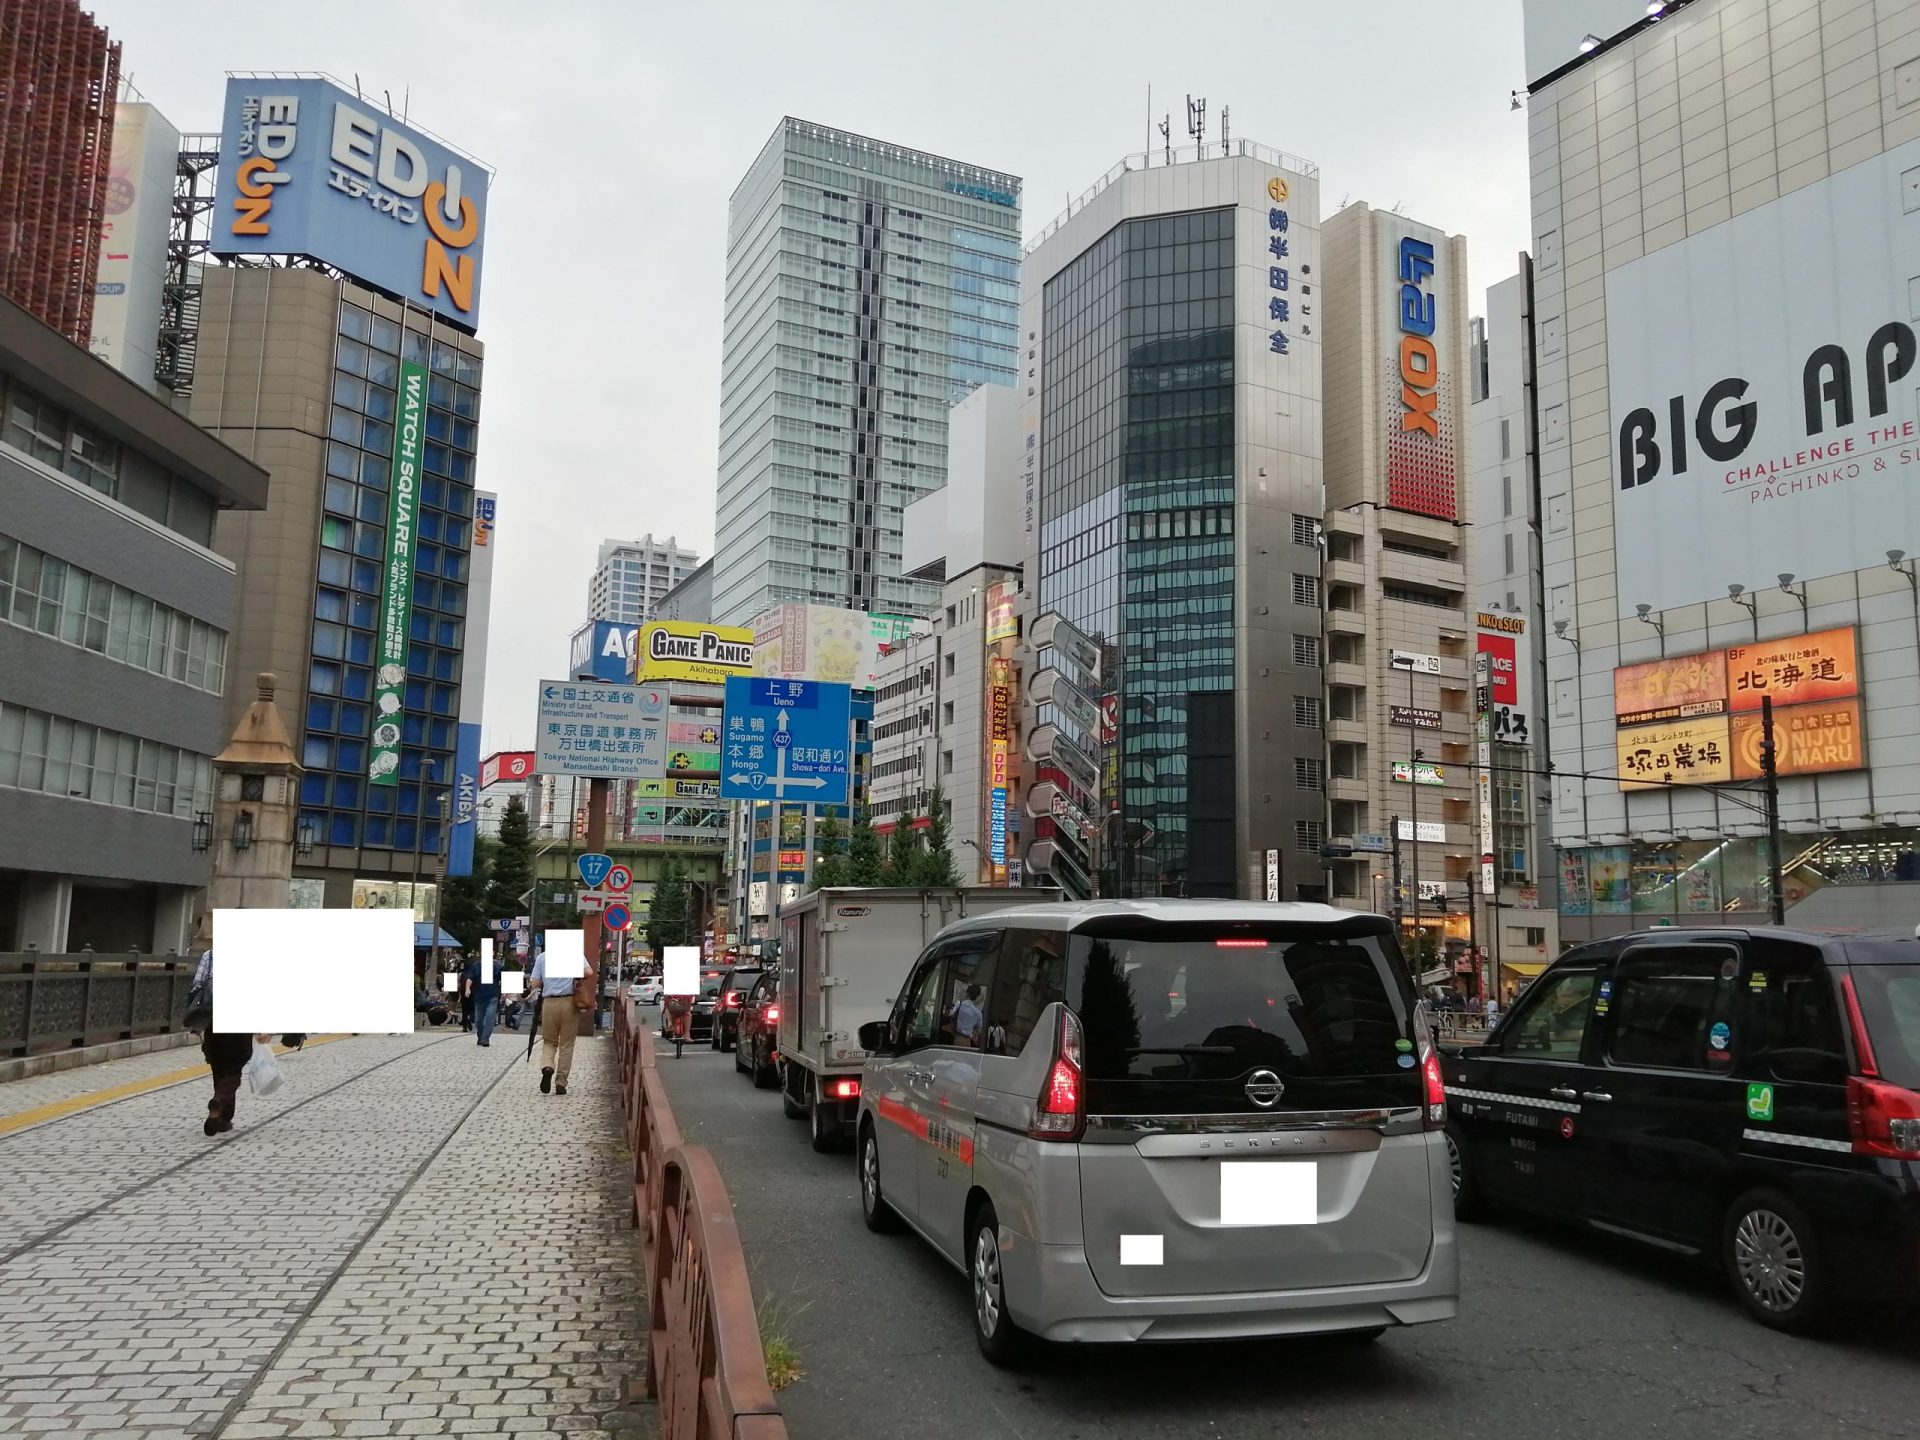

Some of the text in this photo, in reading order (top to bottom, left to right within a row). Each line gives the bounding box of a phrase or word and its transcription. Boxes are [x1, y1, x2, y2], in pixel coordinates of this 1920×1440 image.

[238, 95, 259, 157] エディオン
[231, 95, 299, 236] EDION
[327, 166, 420, 225] エディオン
[330, 101, 479, 312] EDION
[1619, 377, 1758, 491] BIG
[1725, 420, 1915, 485] CHALLENGE THE
[393, 375, 421, 556] WATCH SQUARE
[1751, 462, 1861, 504] PACHINKO
[1873, 457, 1887, 472] &
[571, 629, 592, 672] AOKI
[653, 631, 698, 658] GAME
[1729, 649, 1746, 660] 8F
[1756, 648, 1820, 666] 北の味紀行と地酒
[689, 665, 734, 677] Akihabara
[1737, 657, 1843, 691] 北海道
[563, 687, 636, 705] 国土交通省
[765, 681, 804, 697] 上野
[542, 700, 567, 709] Ministry
[568, 701, 576, 709] of
[773, 697, 795, 706] Ueno
[541, 708, 629, 721] Infrastructure and Transport
[546, 722, 658, 741] 東京国道事務所
[729, 715, 766, 733] 巣鴨
[558, 737, 646, 754] 万世橋出張所
[729, 732, 765, 742] Sugamo
[775, 734, 789, 744] 437
[1791, 726, 1852, 750] NIJYU
[543, 752, 659, 766] Tokyo National Highway Office
[728, 743, 764, 760] 本郷
[792, 747, 844, 764] 昭和通り
[1625, 742, 1722, 776] 塚田農場
[1792, 744, 1853, 767] MARU
[563, 762, 639, 773] Manseibashi Branch
[731, 760, 760, 770] Hongo
[791, 762, 847, 774] Showa-dori Ave.
[993, 753, 1005, 784] DVD
[675, 780, 700, 796] GAME
[752, 775, 763, 785] 17
[457, 772, 474, 826] AKIBA
[588, 862, 603, 875] 17
[501, 920, 510, 929] 17
[1505, 1111, 1539, 1127] FUTAMI
[1200, 1135, 1328, 1149] SERENA
